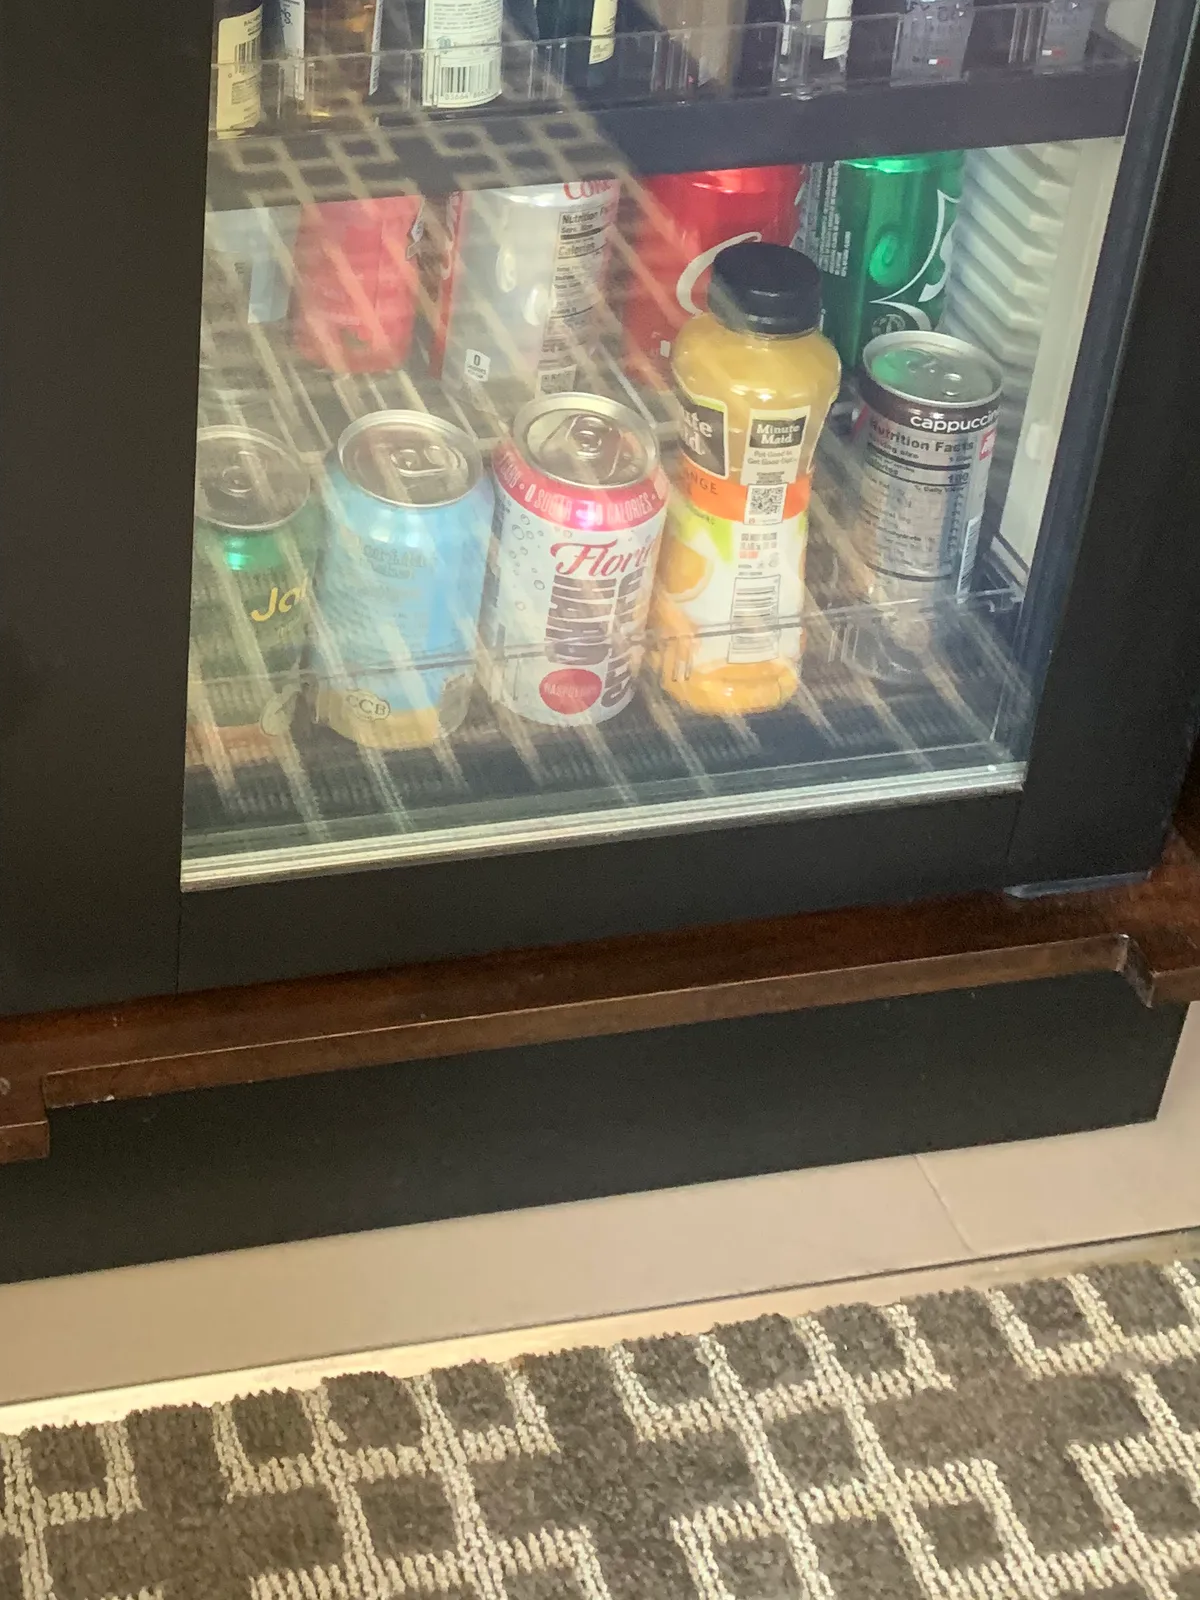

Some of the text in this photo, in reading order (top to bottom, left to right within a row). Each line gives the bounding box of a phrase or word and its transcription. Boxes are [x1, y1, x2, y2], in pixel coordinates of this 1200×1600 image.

[474, 354, 481, 367] 0
[756, 423, 800, 435] Minute
[760, 434, 793, 445] Maid
[935, 441, 974, 453] Facts
[606, 492, 654, 524] CALORIES
